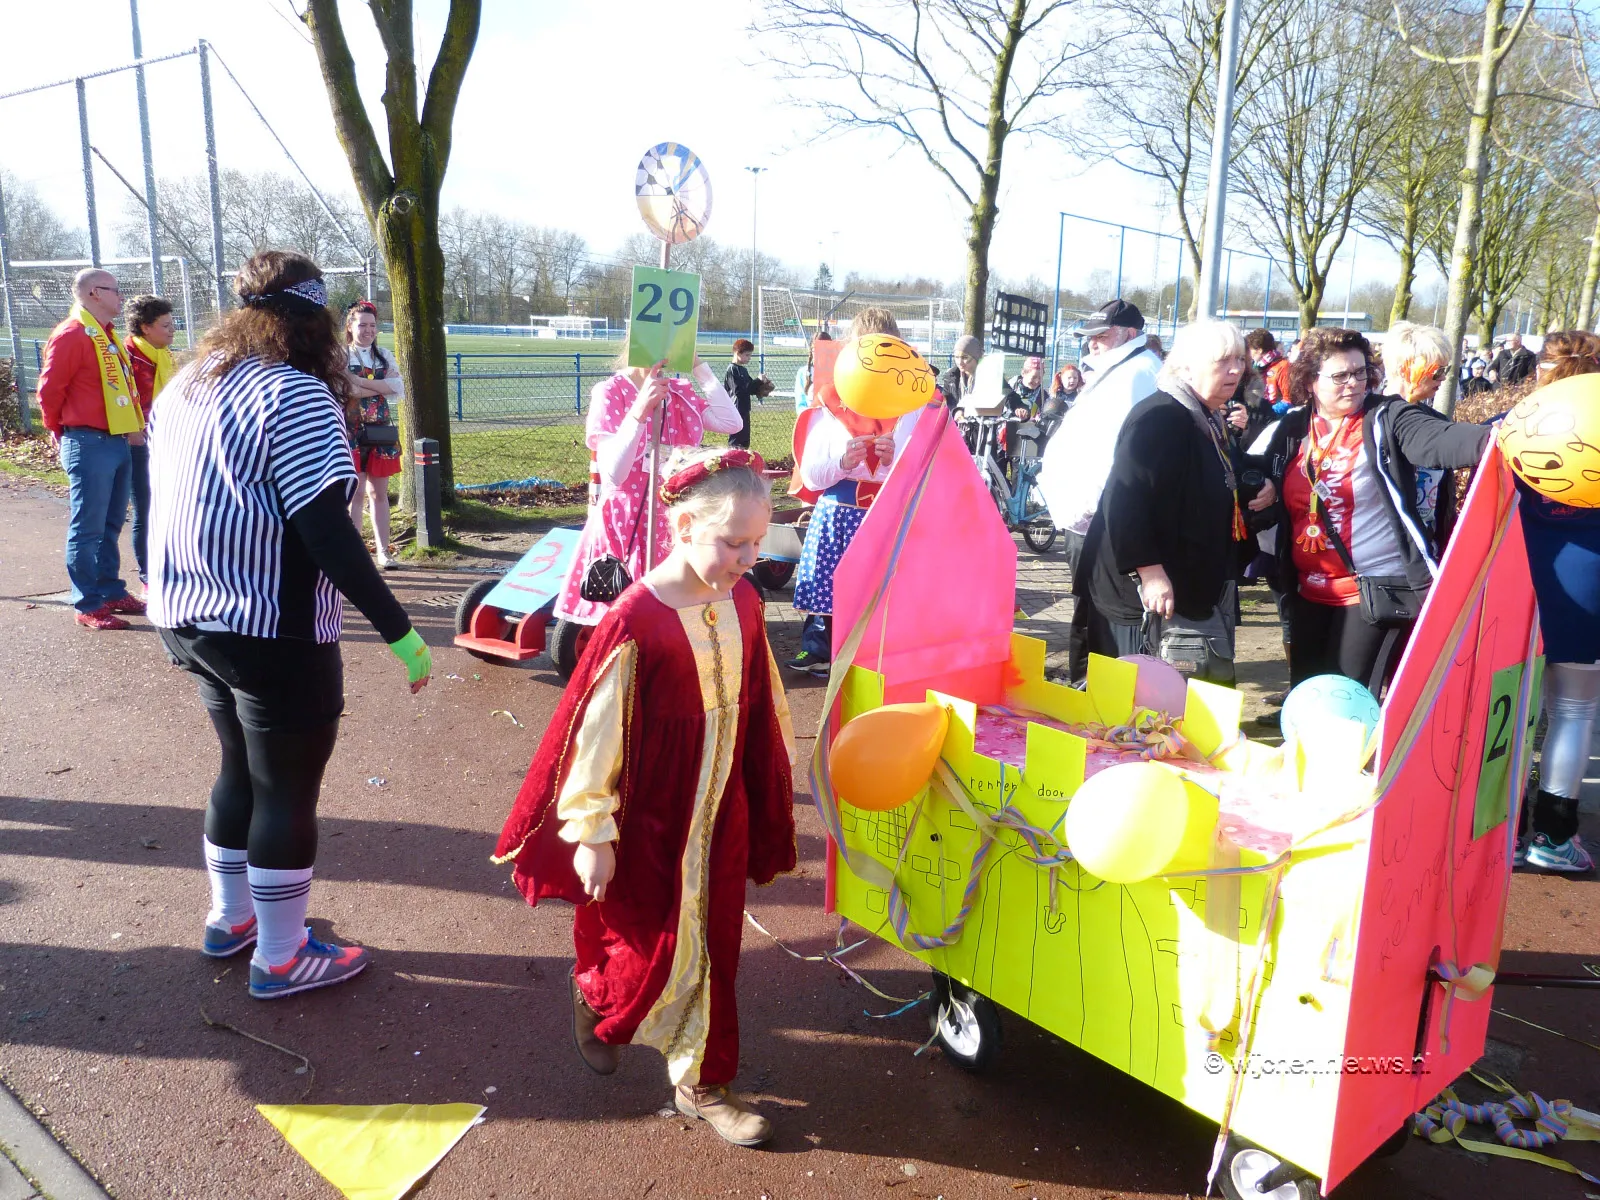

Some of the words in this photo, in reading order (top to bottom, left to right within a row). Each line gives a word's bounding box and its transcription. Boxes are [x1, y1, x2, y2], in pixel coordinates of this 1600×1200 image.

[636, 283, 694, 326] 29
[970, 776, 1018, 792] rennen
[1037, 782, 1065, 797] door
